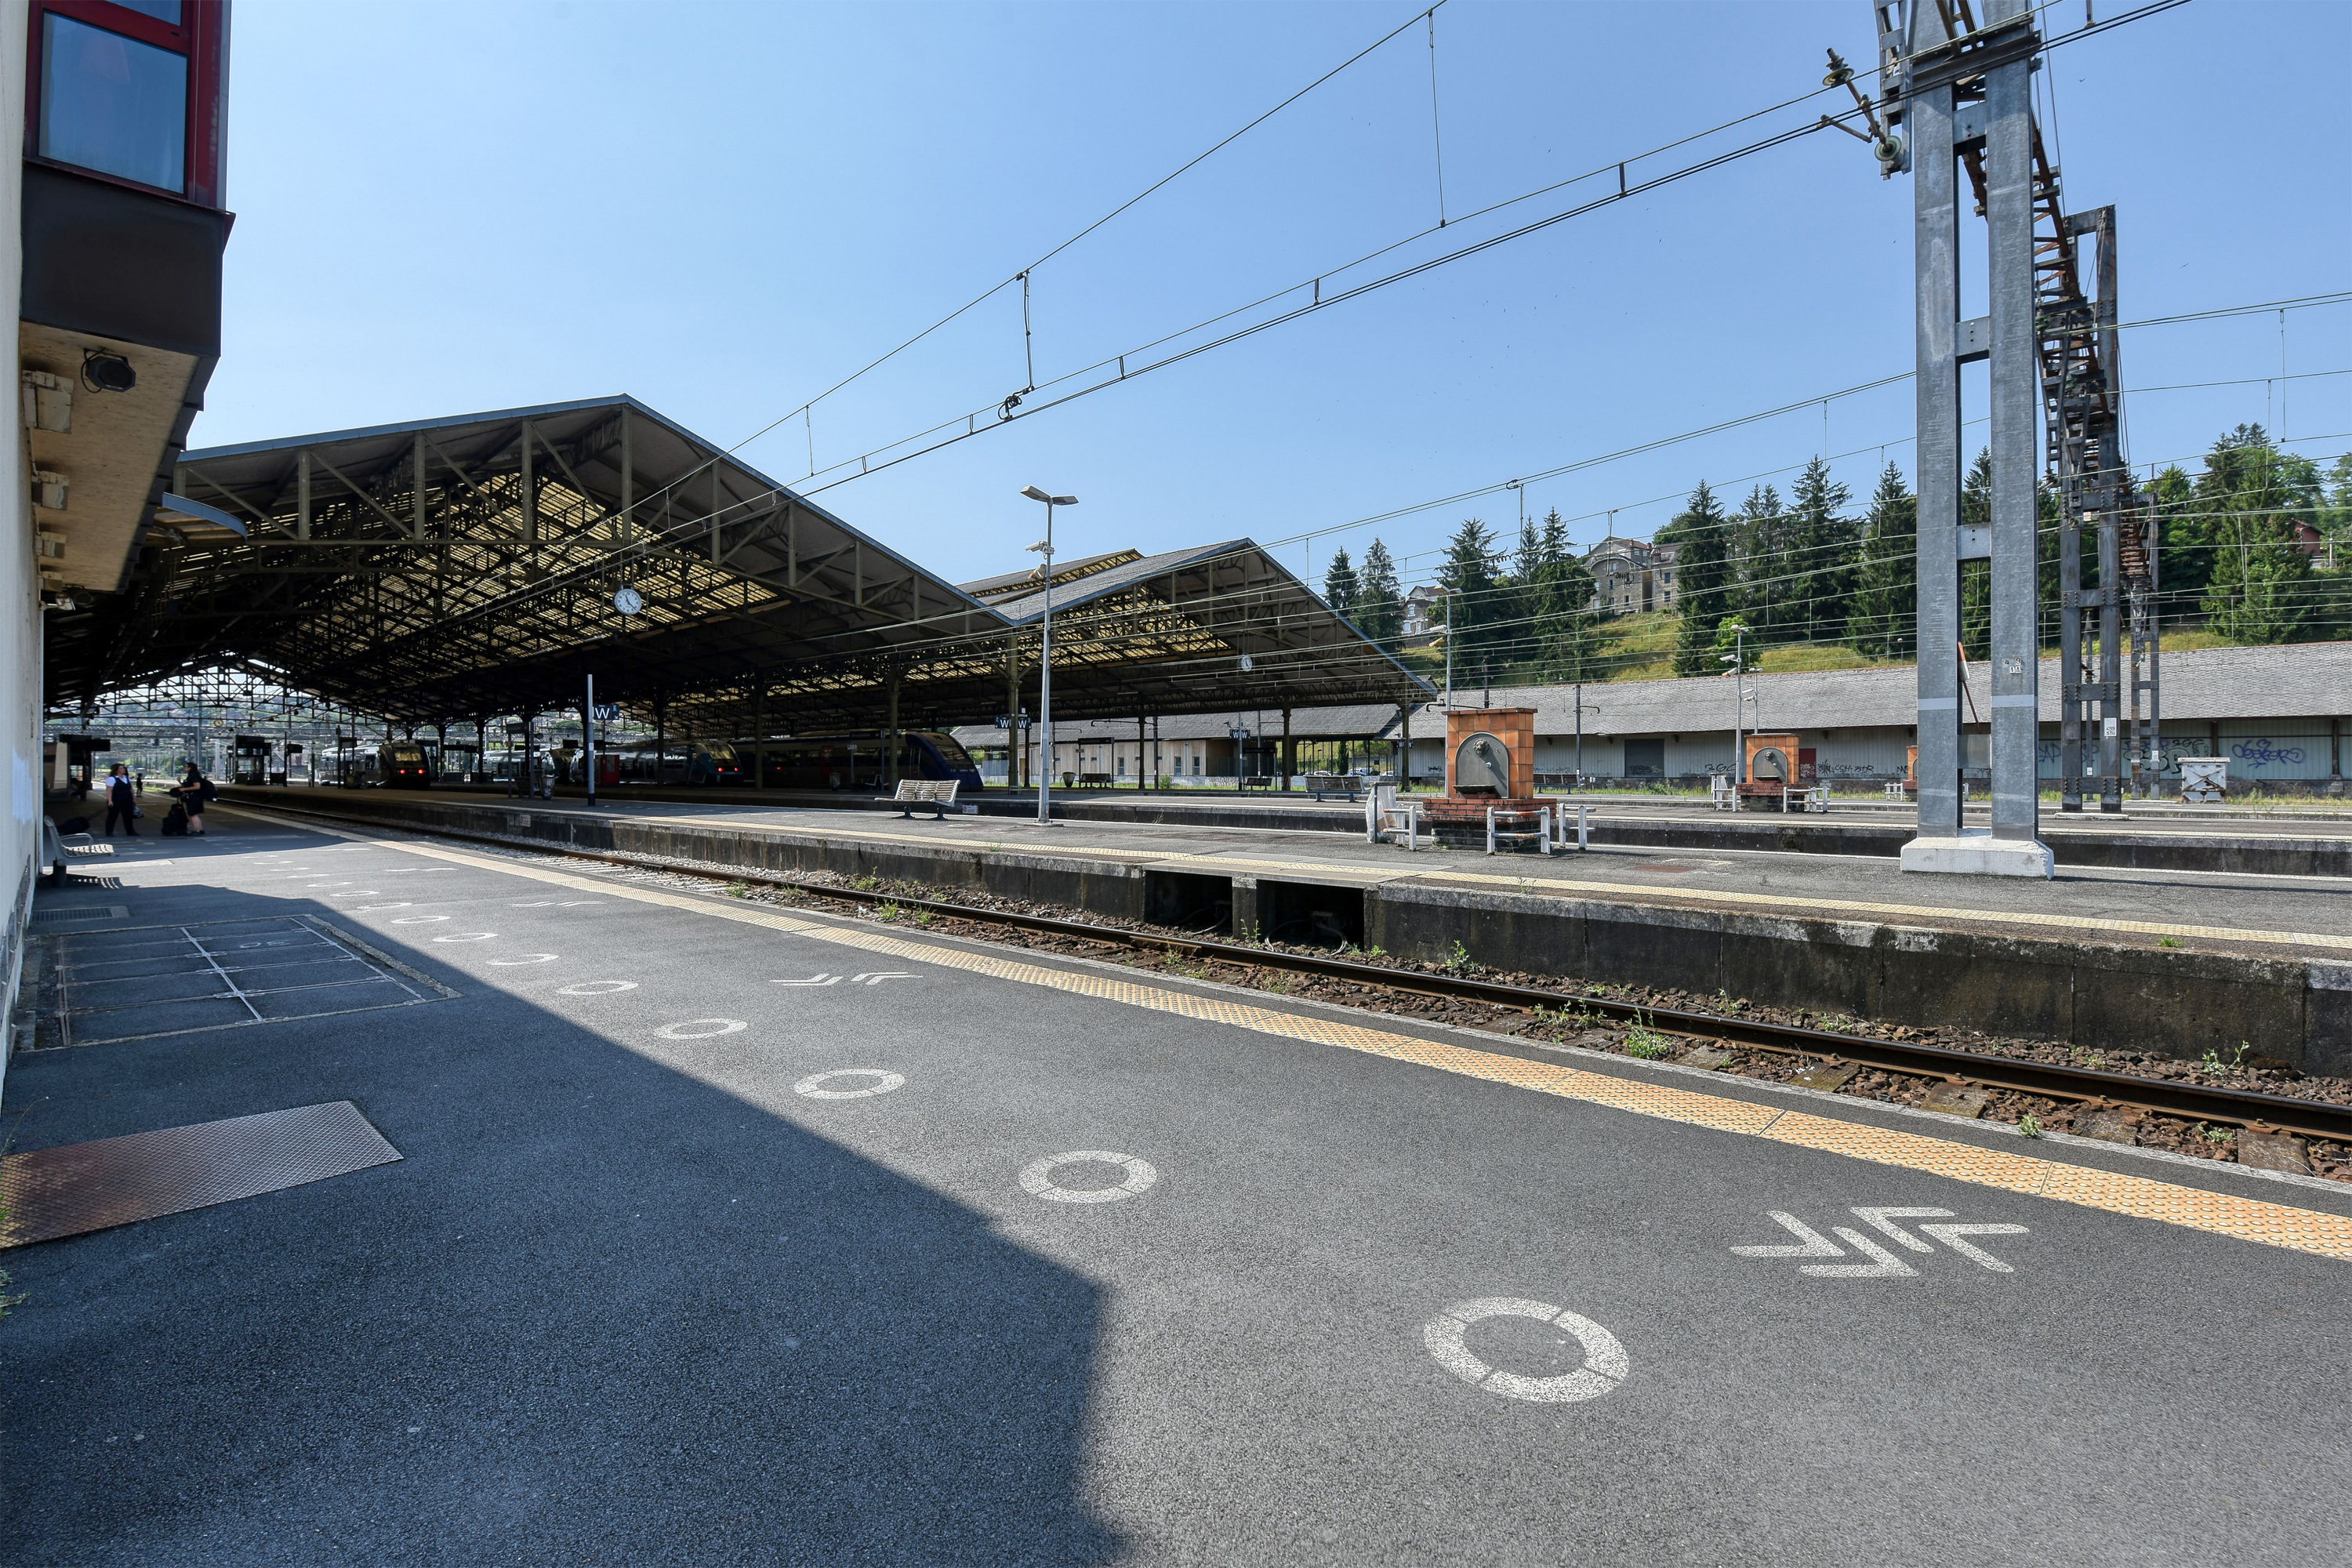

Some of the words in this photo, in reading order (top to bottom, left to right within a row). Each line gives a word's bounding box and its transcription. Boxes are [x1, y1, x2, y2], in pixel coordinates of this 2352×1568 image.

[595, 707, 610, 719] W
[1000, 719, 1009, 728] W
[1018, 720, 1027, 728] W
